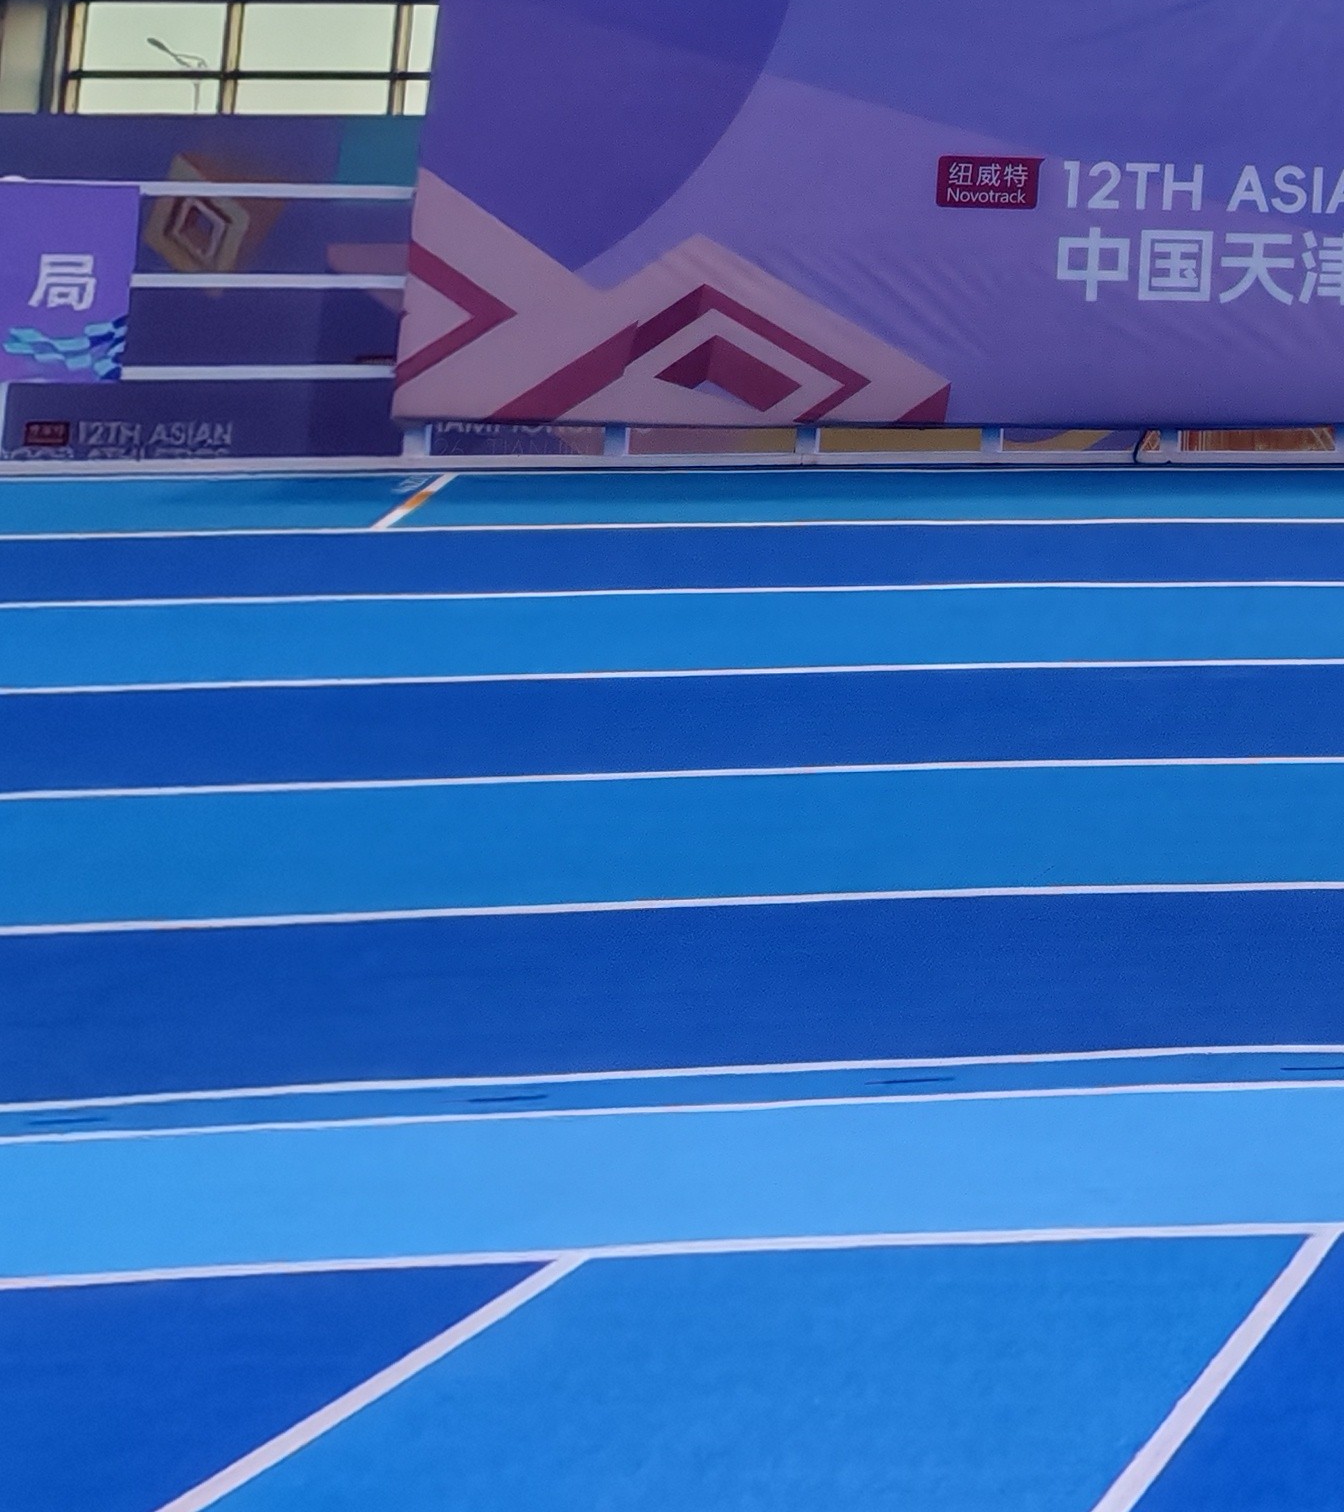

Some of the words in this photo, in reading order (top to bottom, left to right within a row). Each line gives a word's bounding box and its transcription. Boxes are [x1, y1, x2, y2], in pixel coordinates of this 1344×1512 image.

[947, 162, 1029, 189] 纽威特
[1064, 161, 1204, 211] 12TH
[946, 188, 1027, 206] Novotrack
[28, 251, 97, 312] 局
[78, 420, 142, 445] 12TH
[148, 421, 233, 446] ASIAN
